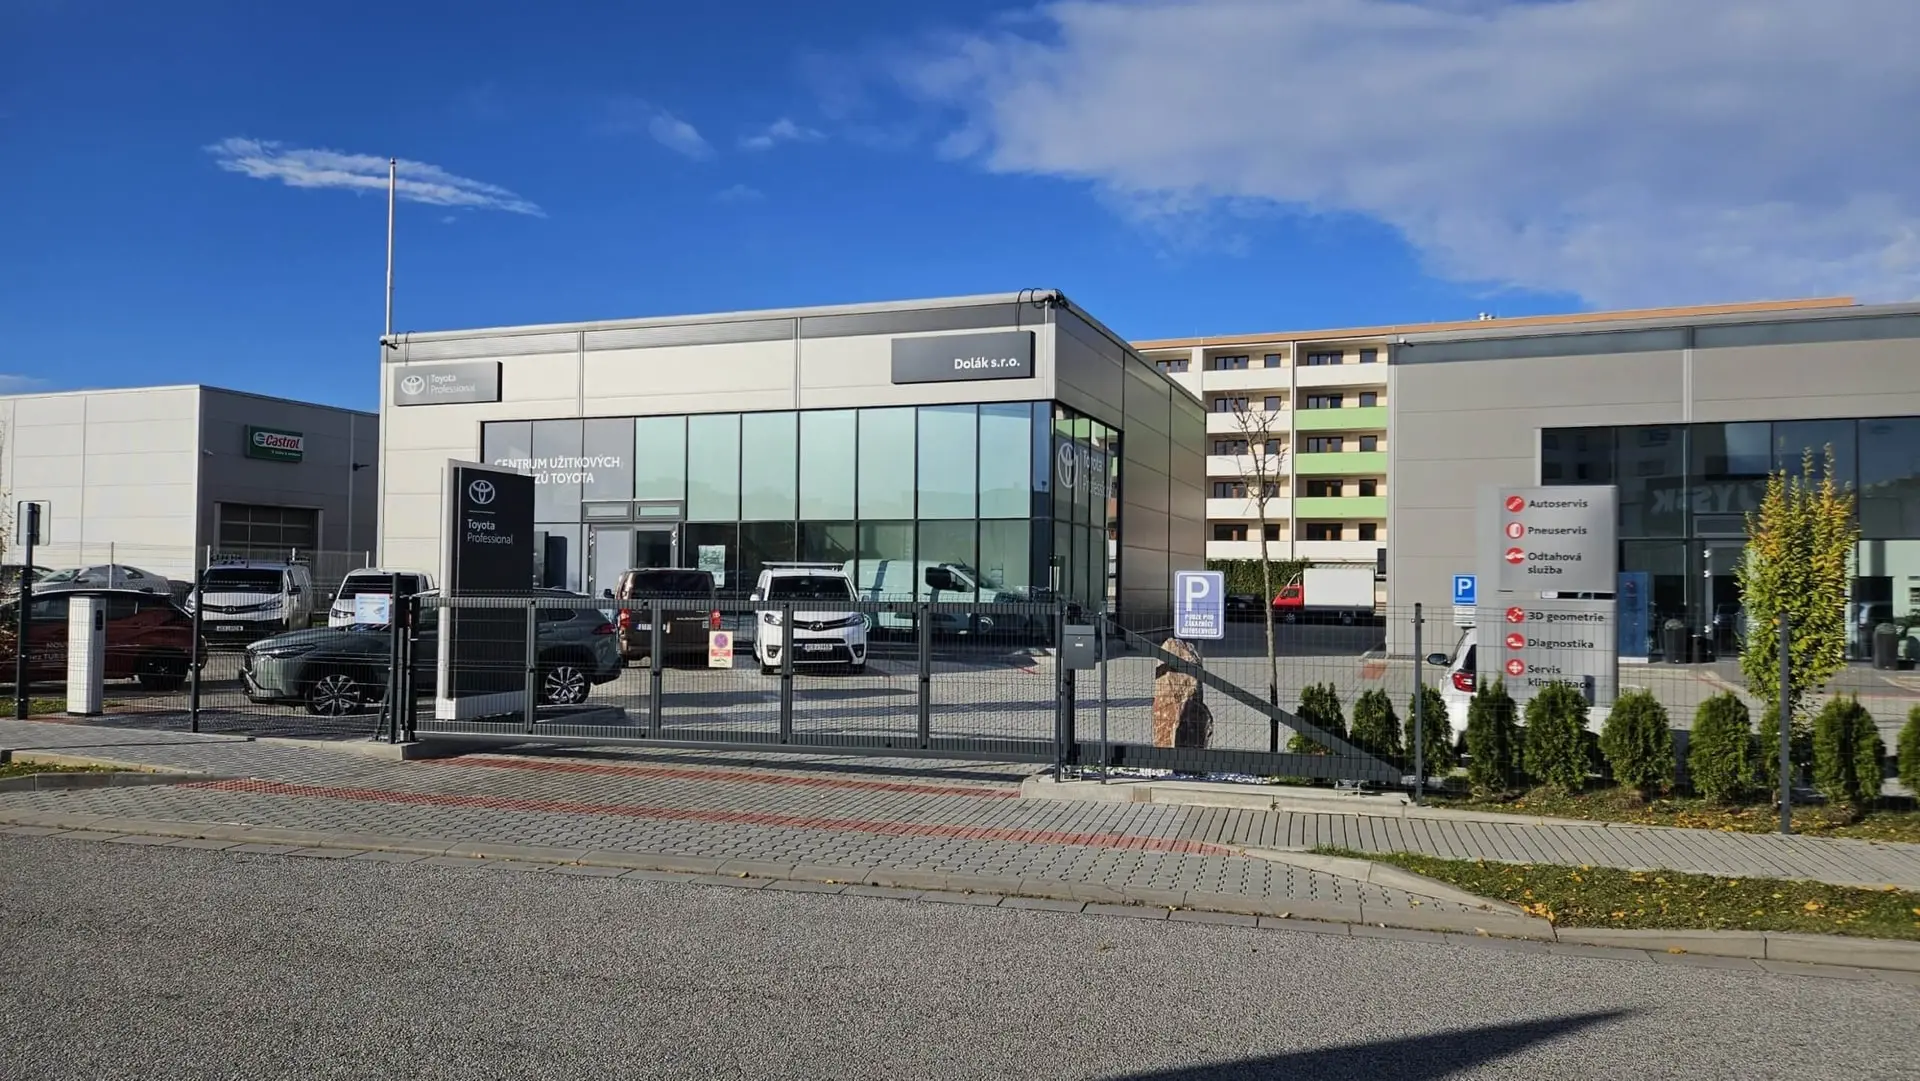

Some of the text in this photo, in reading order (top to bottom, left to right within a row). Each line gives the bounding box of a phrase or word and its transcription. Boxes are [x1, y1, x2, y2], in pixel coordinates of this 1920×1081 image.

[954, 356, 1020, 370] Dolák s.r.o.
[431, 374, 457, 385] Toyota
[431, 384, 477, 395] Professional
[265, 434, 301, 449] Castrol
[549, 454, 620, 469] UŽITKOVÝCH
[551, 471, 595, 484] TOYOTA
[1528, 499, 1588, 508] Autoservis
[467, 518, 496, 532] Toyota
[1527, 526, 1588, 535] Pneuservis
[467, 532, 514, 545] Professional
[1527, 551, 1582, 561] Odtahová
[1527, 565, 1563, 574] služba
[1185, 575, 1210, 612] P
[1457, 578, 1472, 597] P
[1528, 611, 1605, 623] 3D geometrie
[1527, 638, 1594, 649] Diagnostika
[1528, 664, 1561, 674] Servis
[1528, 677, 1592, 689] klimtizace
